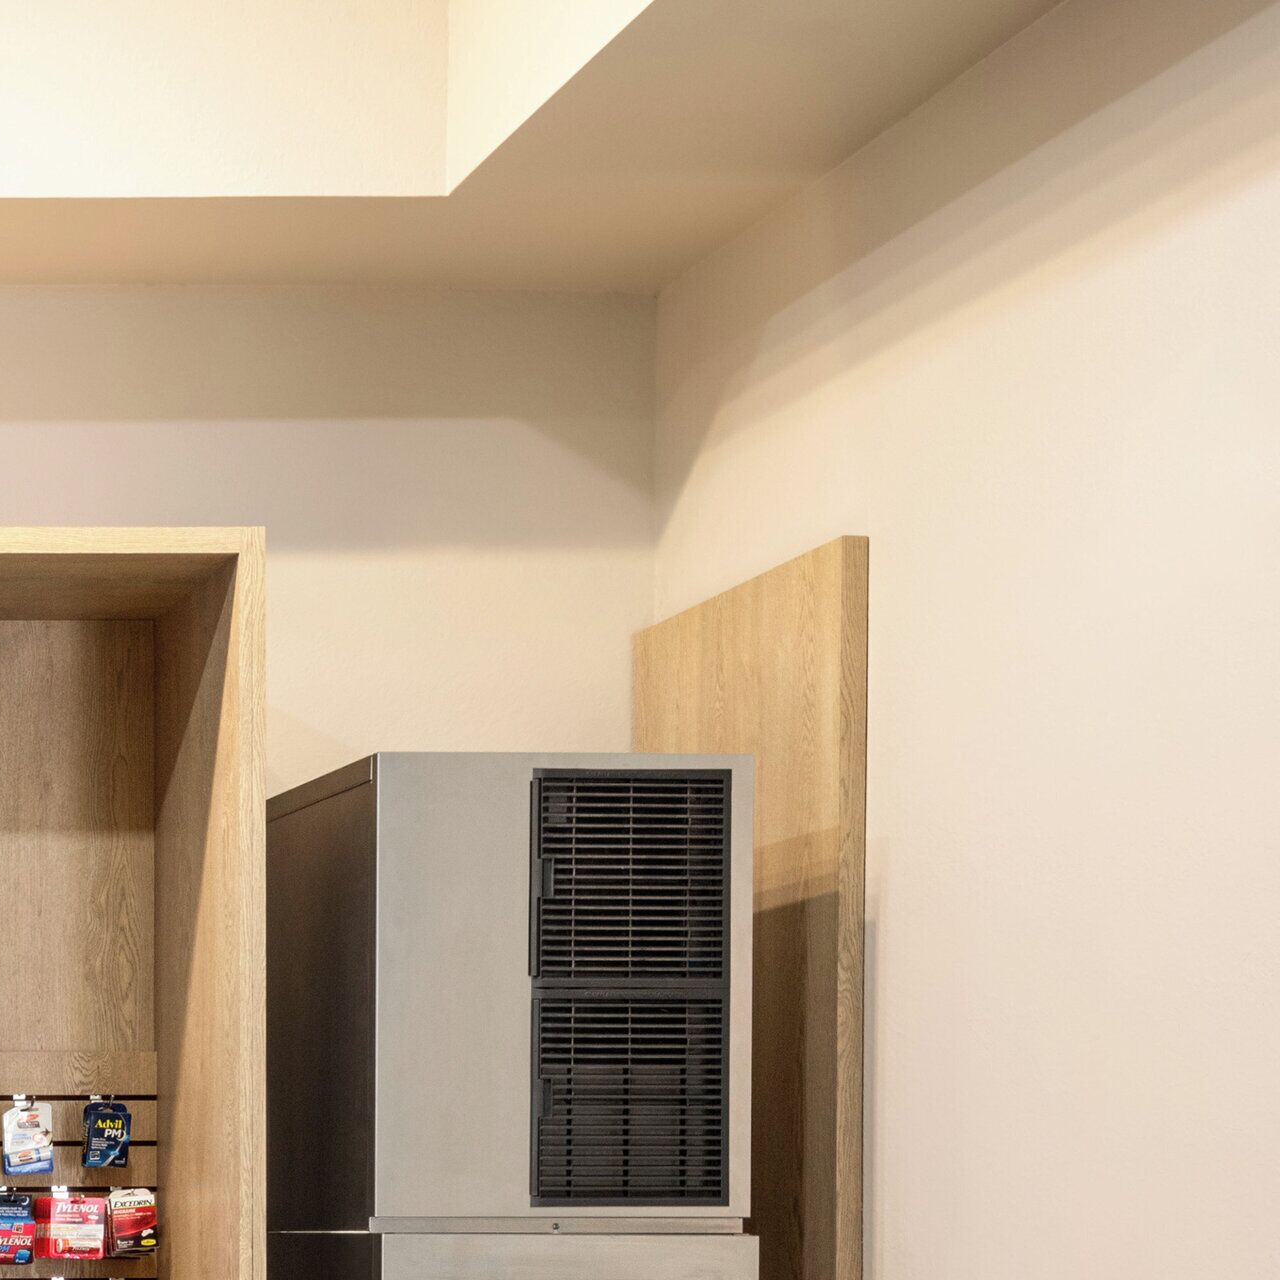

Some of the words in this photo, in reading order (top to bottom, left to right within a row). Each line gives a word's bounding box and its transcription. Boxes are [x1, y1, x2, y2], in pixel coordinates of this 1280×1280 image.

[95, 1119, 123, 1129] Advil
[104, 1128, 121, 1138] PM
[55, 1203, 99, 1213] TYLENOL
[113, 1199, 153, 1209] EXCEDRIN
